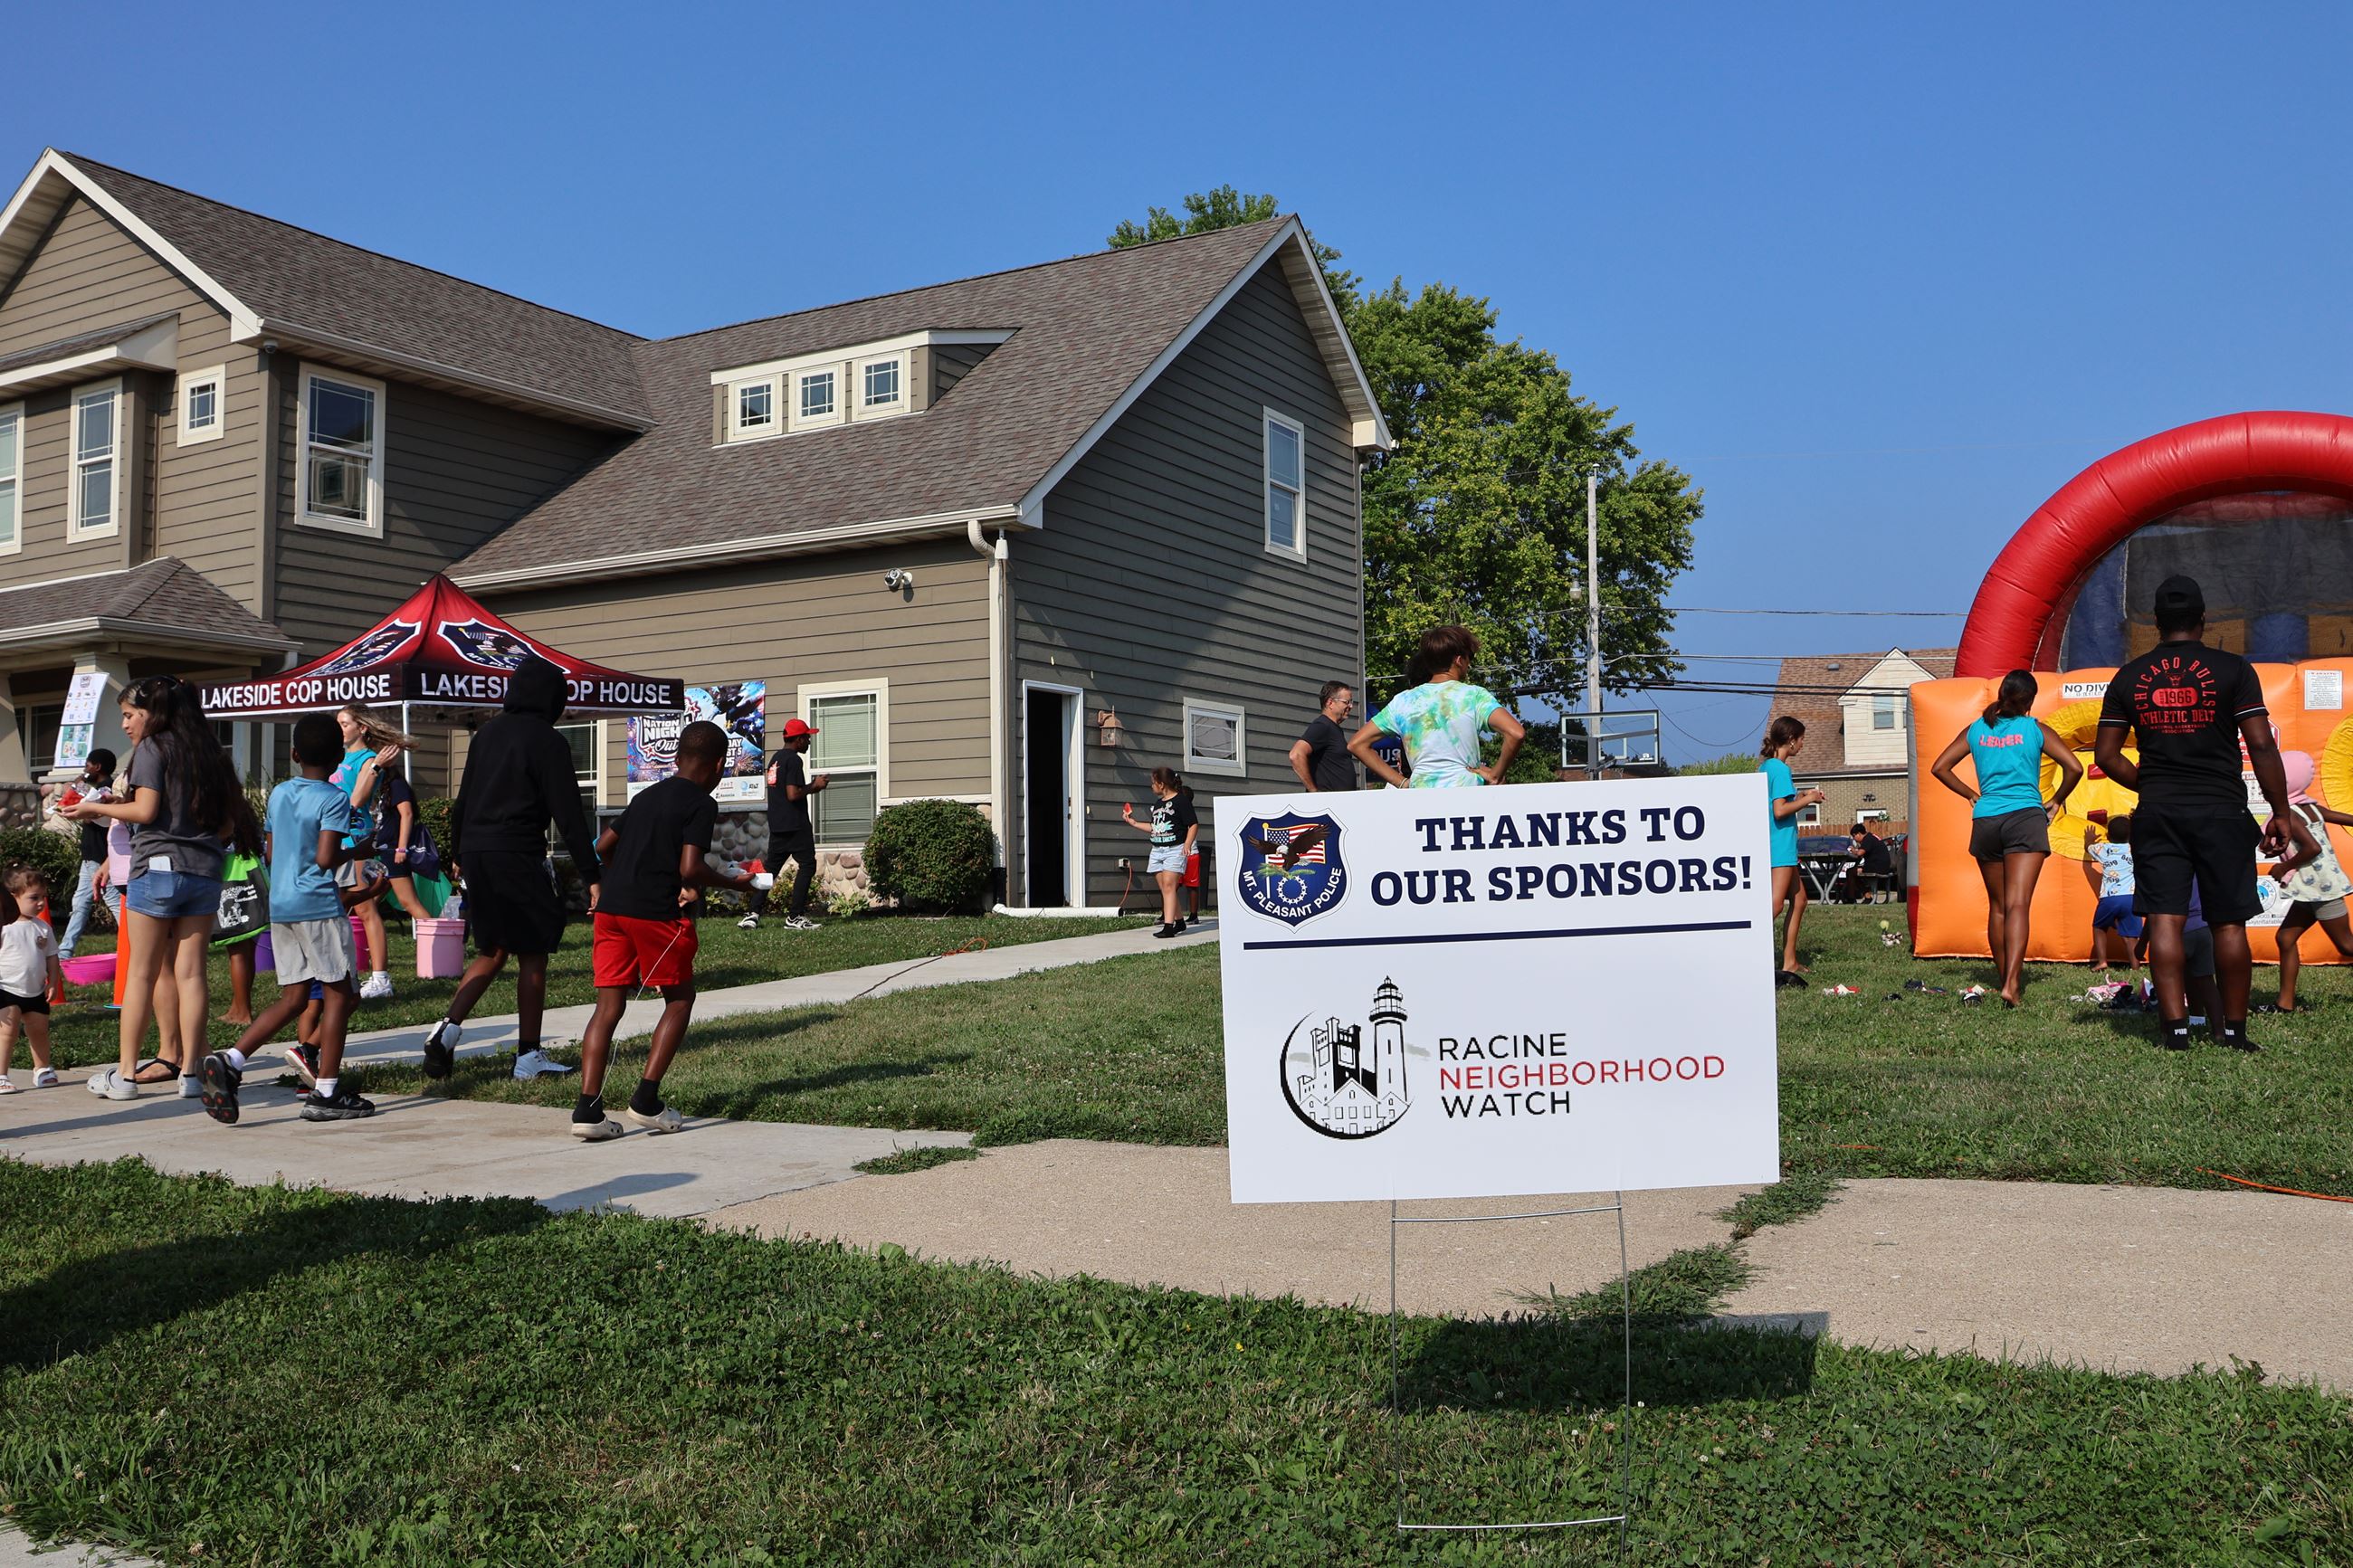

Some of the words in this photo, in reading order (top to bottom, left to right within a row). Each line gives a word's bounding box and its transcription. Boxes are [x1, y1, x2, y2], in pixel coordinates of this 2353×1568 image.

[202, 683, 281, 708] LAKESIDE
[286, 679, 322, 704] COP
[327, 674, 391, 700] HOUSE
[421, 673, 508, 698] LAKESI
[567, 679, 593, 701] OP
[600, 680, 672, 705] HOUSE
[2064, 684, 2082, 693] NO
[2086, 683, 2109, 692] DIV
[2134, 657, 2180, 710] CHICAGO
[2188, 660, 2216, 707] BULLS
[2165, 690, 2193, 705] 1966
[2139, 710, 2187, 725] ATHLETIC
[643, 727, 681, 743] NIGH
[725, 757, 735, 768] 25
[1415, 810, 1627, 852] THANKS
[1640, 805, 1705, 842] TO
[1243, 870, 1257, 891] MT.
[1253, 891, 1312, 917] PLEASANT
[1314, 868, 1342, 908] POLICE
[1371, 869, 1476, 907] OUR
[1489, 855, 1751, 902] SPONSORS!
[1439, 1033, 1567, 1061] RACINE
[1440, 1056, 1725, 1090] NEIGHBORHOOD
[1441, 1090, 1570, 1118] WATCH
